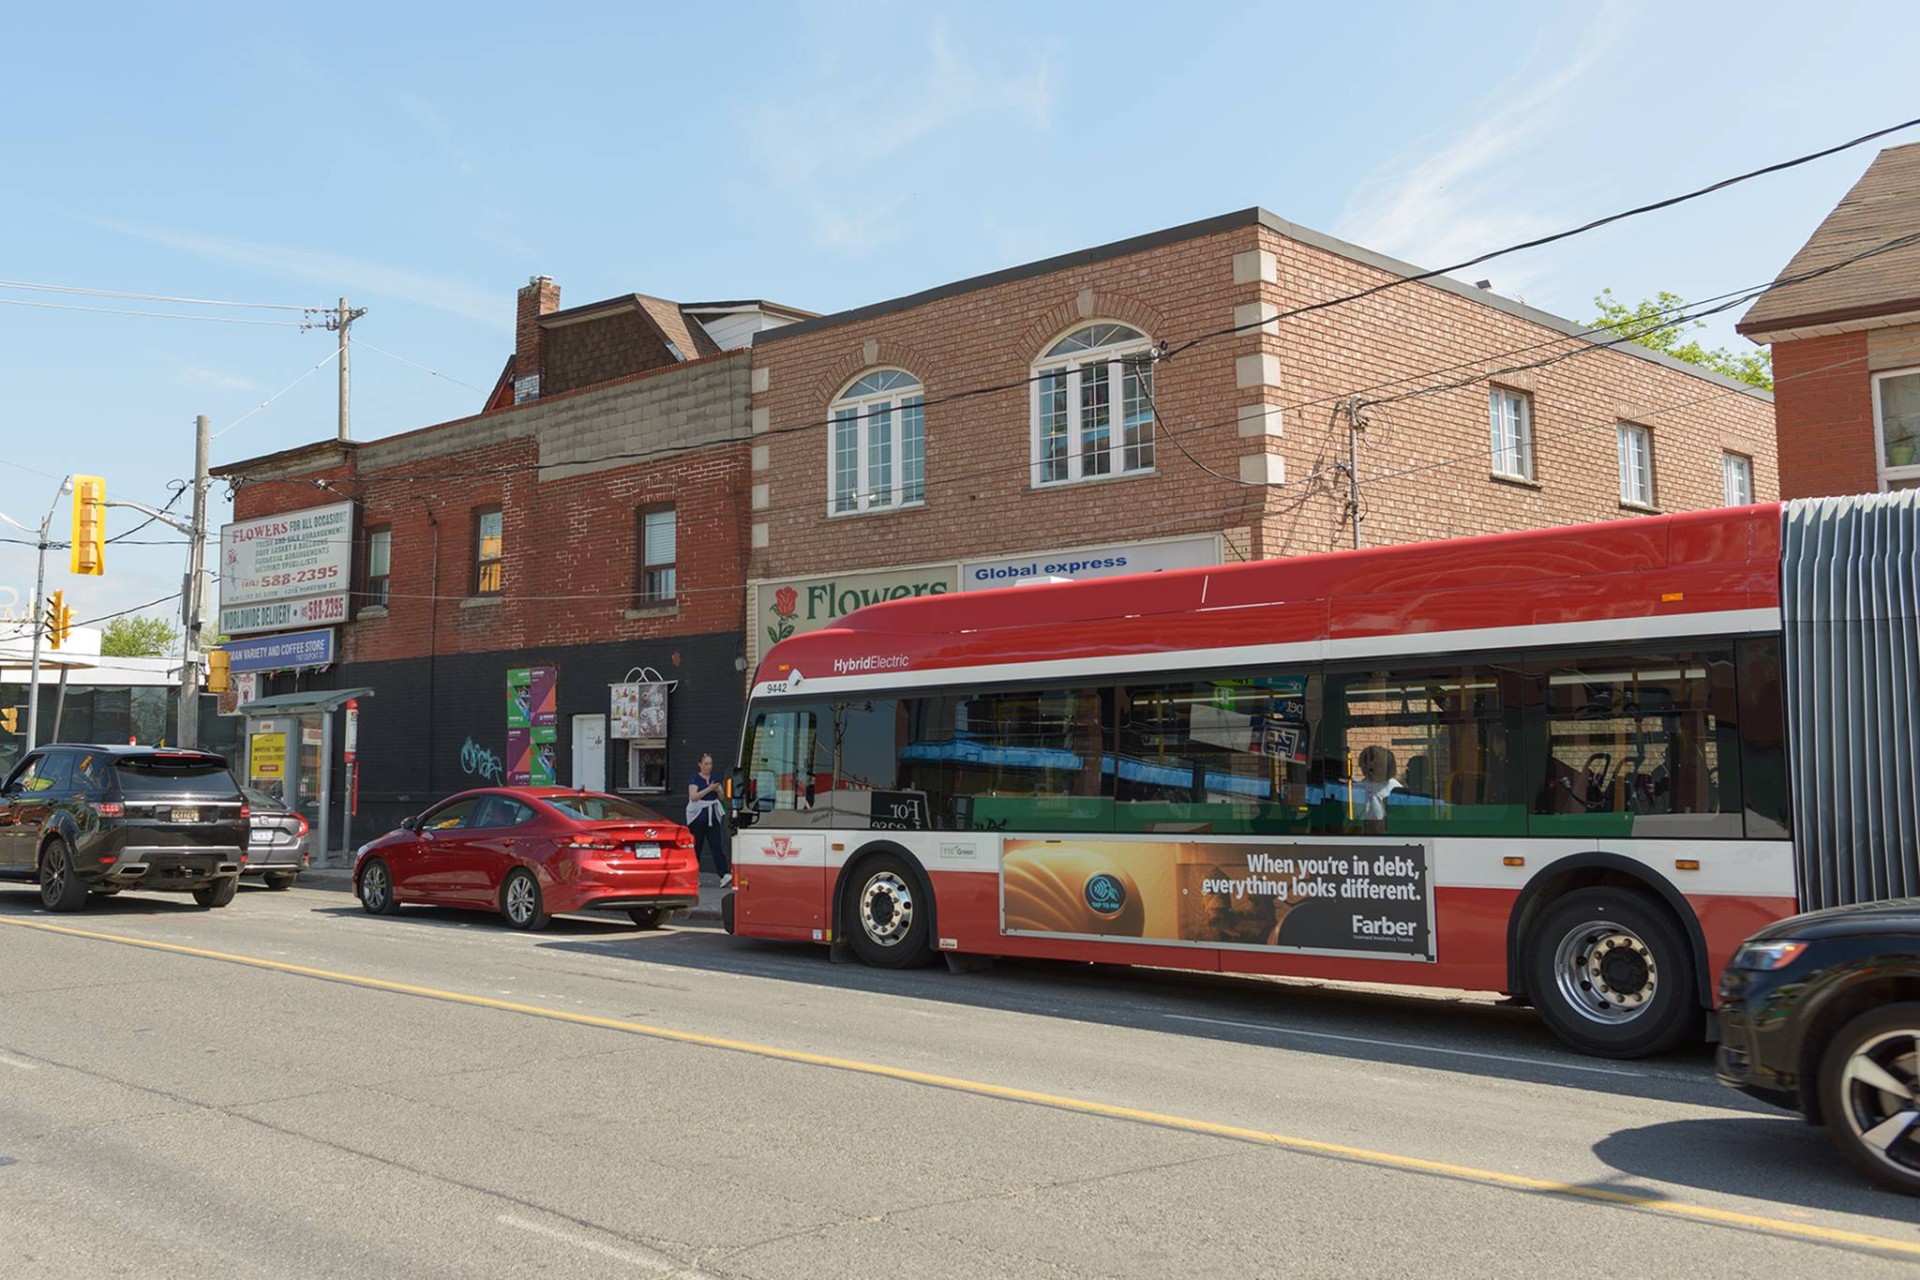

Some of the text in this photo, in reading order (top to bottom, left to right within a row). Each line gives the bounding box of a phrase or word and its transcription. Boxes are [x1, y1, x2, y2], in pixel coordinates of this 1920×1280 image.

[232, 511, 347, 544] FLOWERS FOR ALL OCCASIONS
[261, 565, 338, 588] 588-2395
[975, 556, 1127, 580] Global express
[223, 608, 260, 631] WORLDWIDE
[261, 604, 291, 627] DELIVERY
[308, 597, 344, 621] 588-2395
[243, 647, 268, 660] VARIETY
[267, 645, 280, 657] AND
[281, 642, 304, 656] COFFEE
[304, 639, 325, 653] STORE
[834, 654, 910, 674] HybridElectric
[767, 683, 788, 694] 9442
[1247, 853, 1420, 880] When you're in debt,
[1202, 875, 1421, 901] everything looks different.
[1352, 914, 1417, 936] Farber
